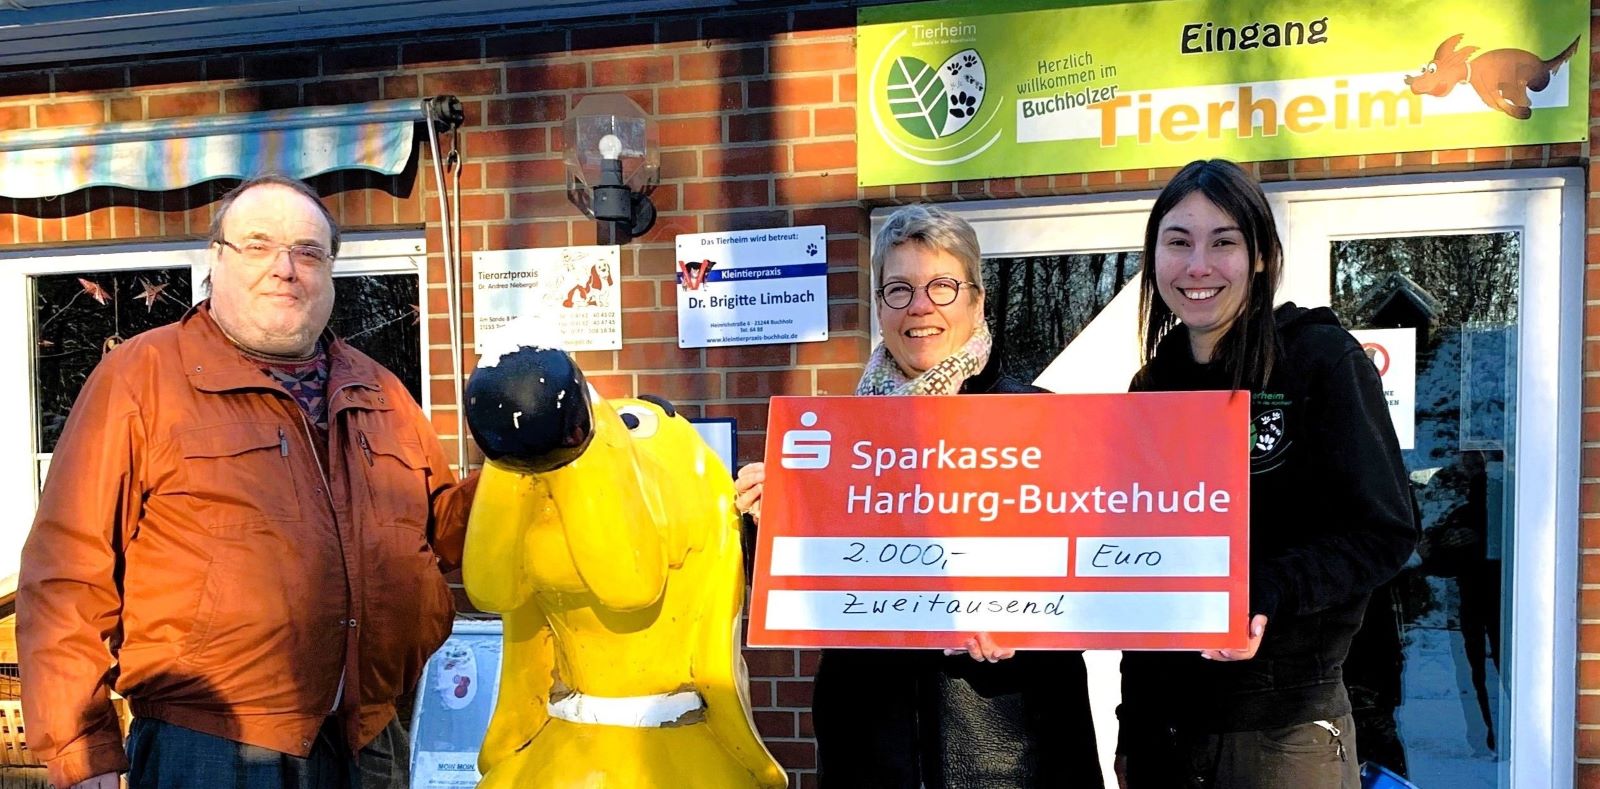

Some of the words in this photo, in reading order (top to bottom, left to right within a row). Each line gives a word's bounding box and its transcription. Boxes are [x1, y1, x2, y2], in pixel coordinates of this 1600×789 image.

[911, 21, 977, 39] Tierheim
[1180, 16, 1330, 54] Eingang
[1037, 51, 1093, 75] Herzlich
[1016, 69, 1096, 95] willkommen
[1100, 64, 1117, 79] im
[1022, 85, 1118, 119] Buchholzer
[1086, 79, 1423, 147] Tierheim
[701, 238, 714, 246] Das
[716, 235, 748, 245] Tierheim
[750, 235, 766, 243] wird
[768, 233, 799, 241] betreut:
[478, 269, 539, 281] Tierarztpraxis
[721, 267, 781, 280] Kleintierpraxis
[689, 297, 706, 309] Dr.
[710, 294, 756, 309] Brigitte
[760, 290, 814, 305] Limbach
[1252, 391, 1285, 400] erheim
[850, 439, 1042, 475] Sparkasse
[846, 480, 1232, 522] Harburg-Buxtehude
[843, 543, 968, 571] 2.000,-
[1092, 543, 1163, 568] Euro
[842, 592, 1066, 617] Zweitausend
